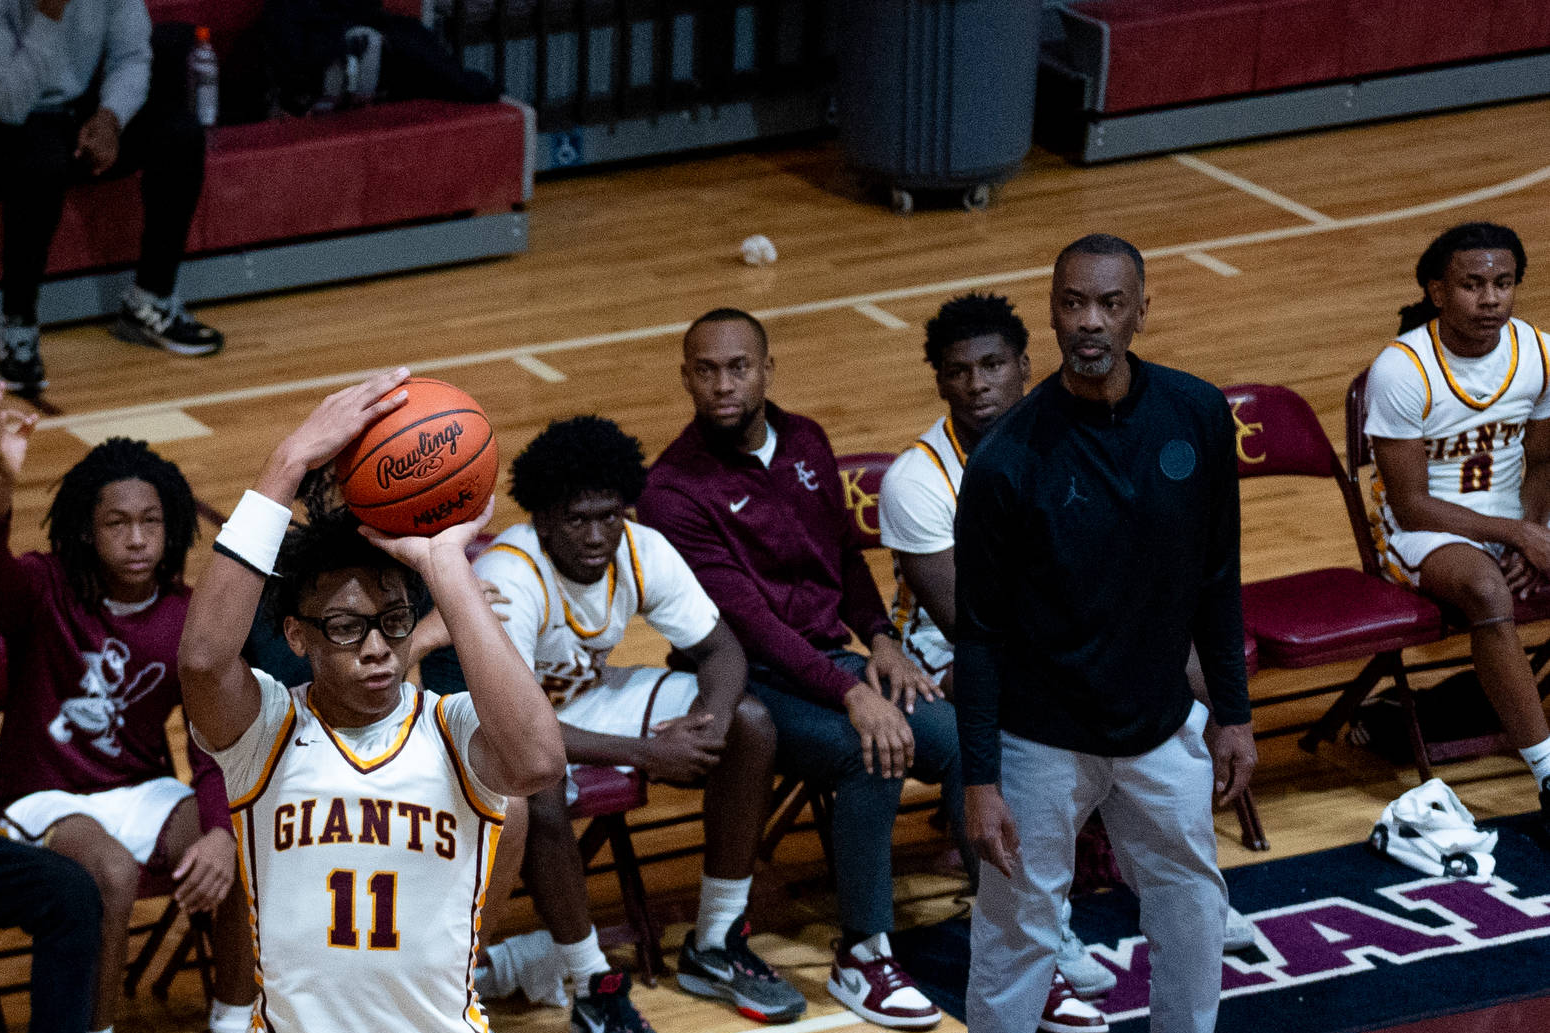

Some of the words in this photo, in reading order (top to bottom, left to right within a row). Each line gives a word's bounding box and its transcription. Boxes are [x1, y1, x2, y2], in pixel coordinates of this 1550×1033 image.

[377, 421, 464, 489] Rawlings
[793, 460, 820, 492] KC
[838, 467, 882, 536] KC
[274, 797, 458, 861] GIANTS
[326, 868, 401, 951] 11
